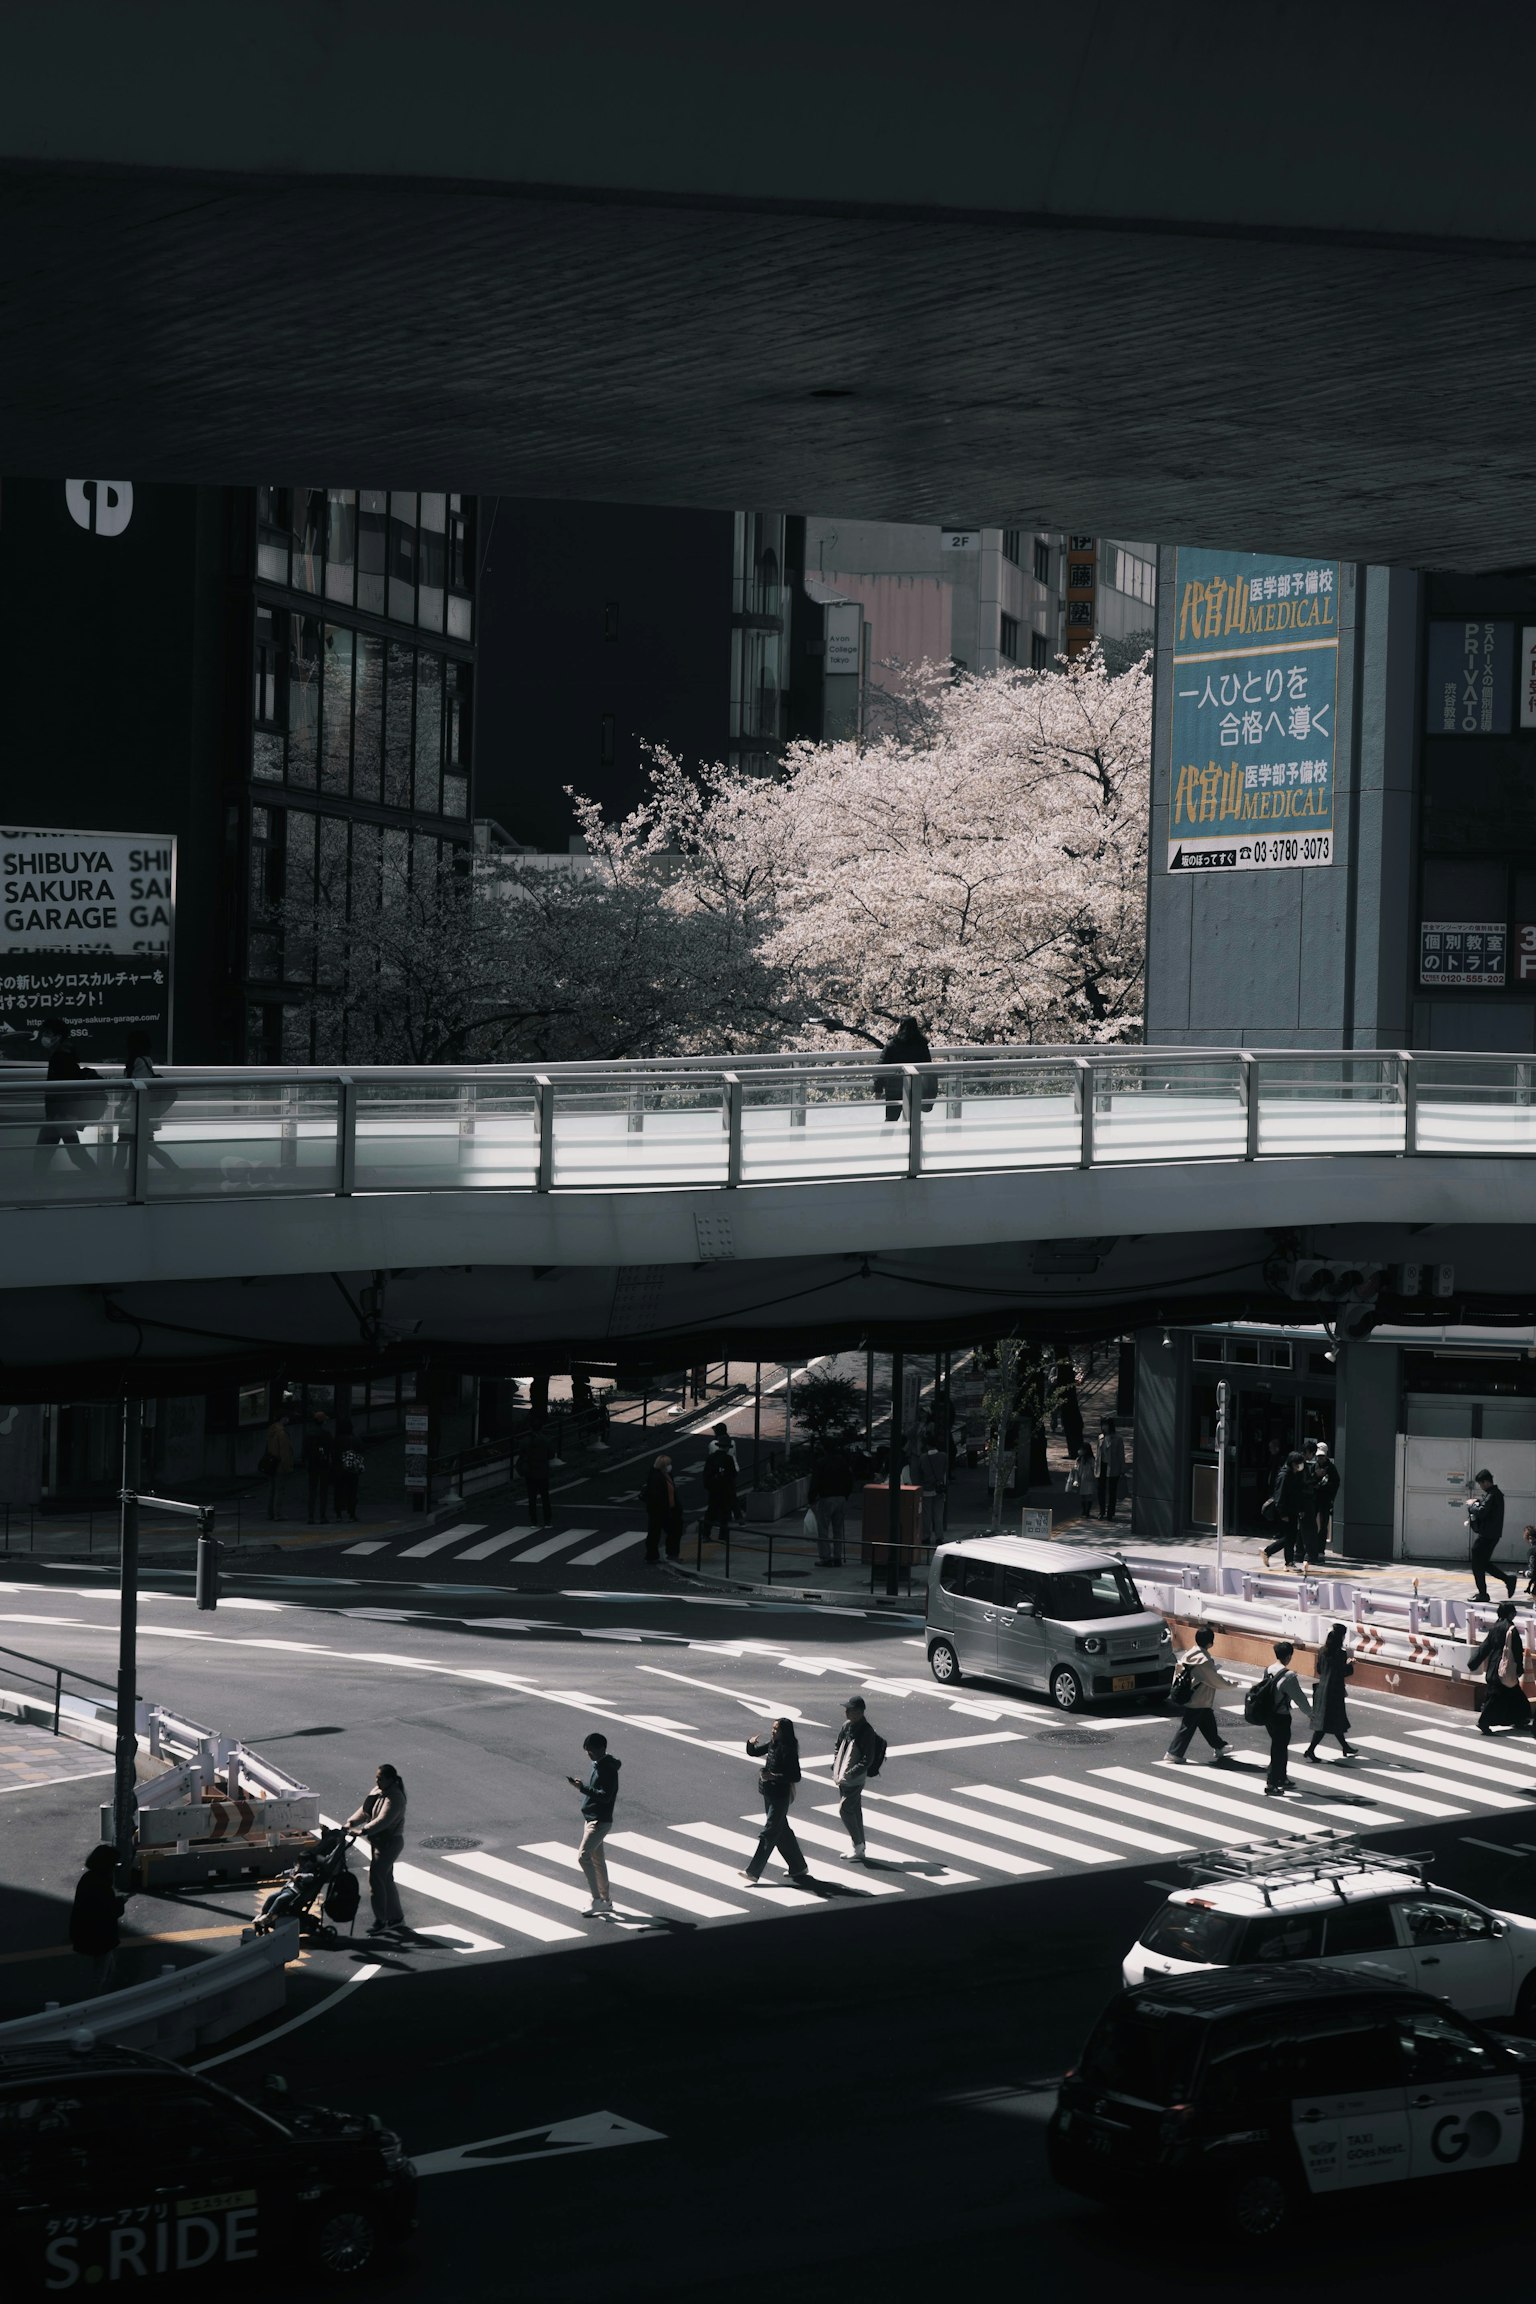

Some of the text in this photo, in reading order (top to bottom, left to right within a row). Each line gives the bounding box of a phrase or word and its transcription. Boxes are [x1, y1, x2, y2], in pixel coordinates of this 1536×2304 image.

[952, 536, 969, 547] 2F
[1179, 568, 1333, 641] 代官山 医学部予備校
[1245, 596, 1333, 634] MEDICAL
[829, 646, 858, 654] College
[1179, 665, 1308, 709] 一人ひとりを
[1443, 682, 1457, 730] 渋谷教室
[1219, 704, 1330, 746] 合格へ導く
[1174, 759, 1328, 825] 代官山 医学部予備校
[1240, 787, 1329, 820] MEDICAL
[1254, 837, 1329, 863] 03-3780-3073
[4, 852, 113, 875] SHIBUYA
[5, 880, 115, 903] SAKURA
[5, 907, 117, 931] GARAGE
[1424, 934, 1503, 952] 個別教室
[1424, 955, 1502, 971] のトライ
[1441, 975, 1504, 983] 0120-555-202
[1347, 2133, 1373, 2145] TAXI
[46, 2203, 168, 2236] タクシーアプリ
[45, 2208, 258, 2290] S.RIDE
